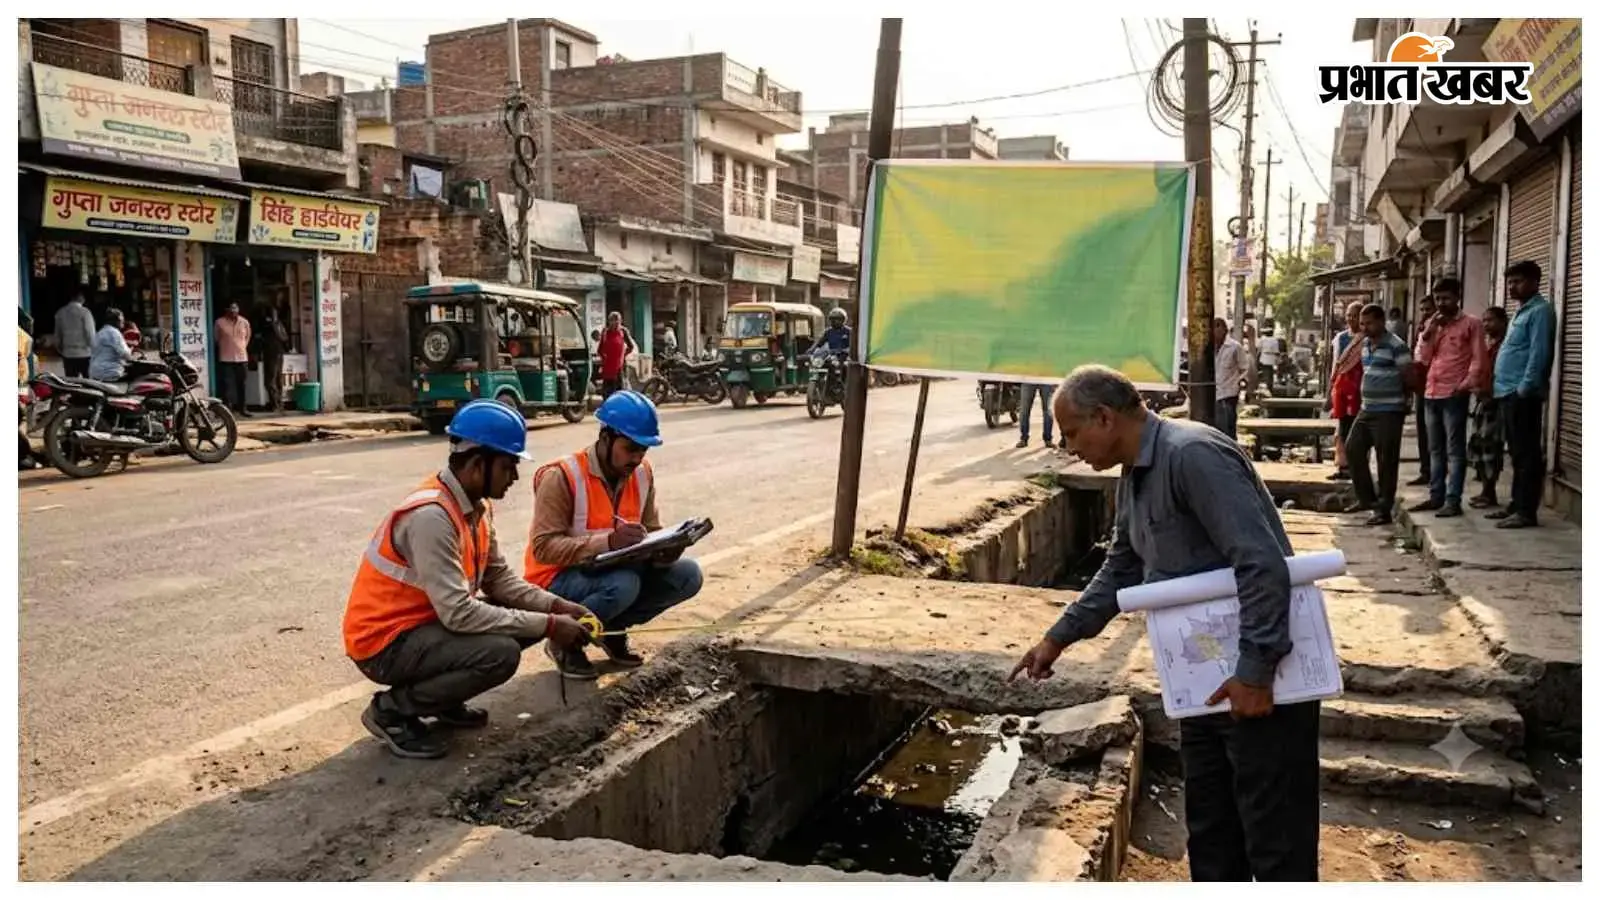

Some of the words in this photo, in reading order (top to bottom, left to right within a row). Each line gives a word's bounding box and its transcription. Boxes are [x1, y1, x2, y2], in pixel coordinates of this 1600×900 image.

[53, 189, 102, 219] गुप्ता
[107, 197, 173, 221] जनरल
[177, 200, 216, 224] स्टोर
[261, 196, 295, 225] सिंह
